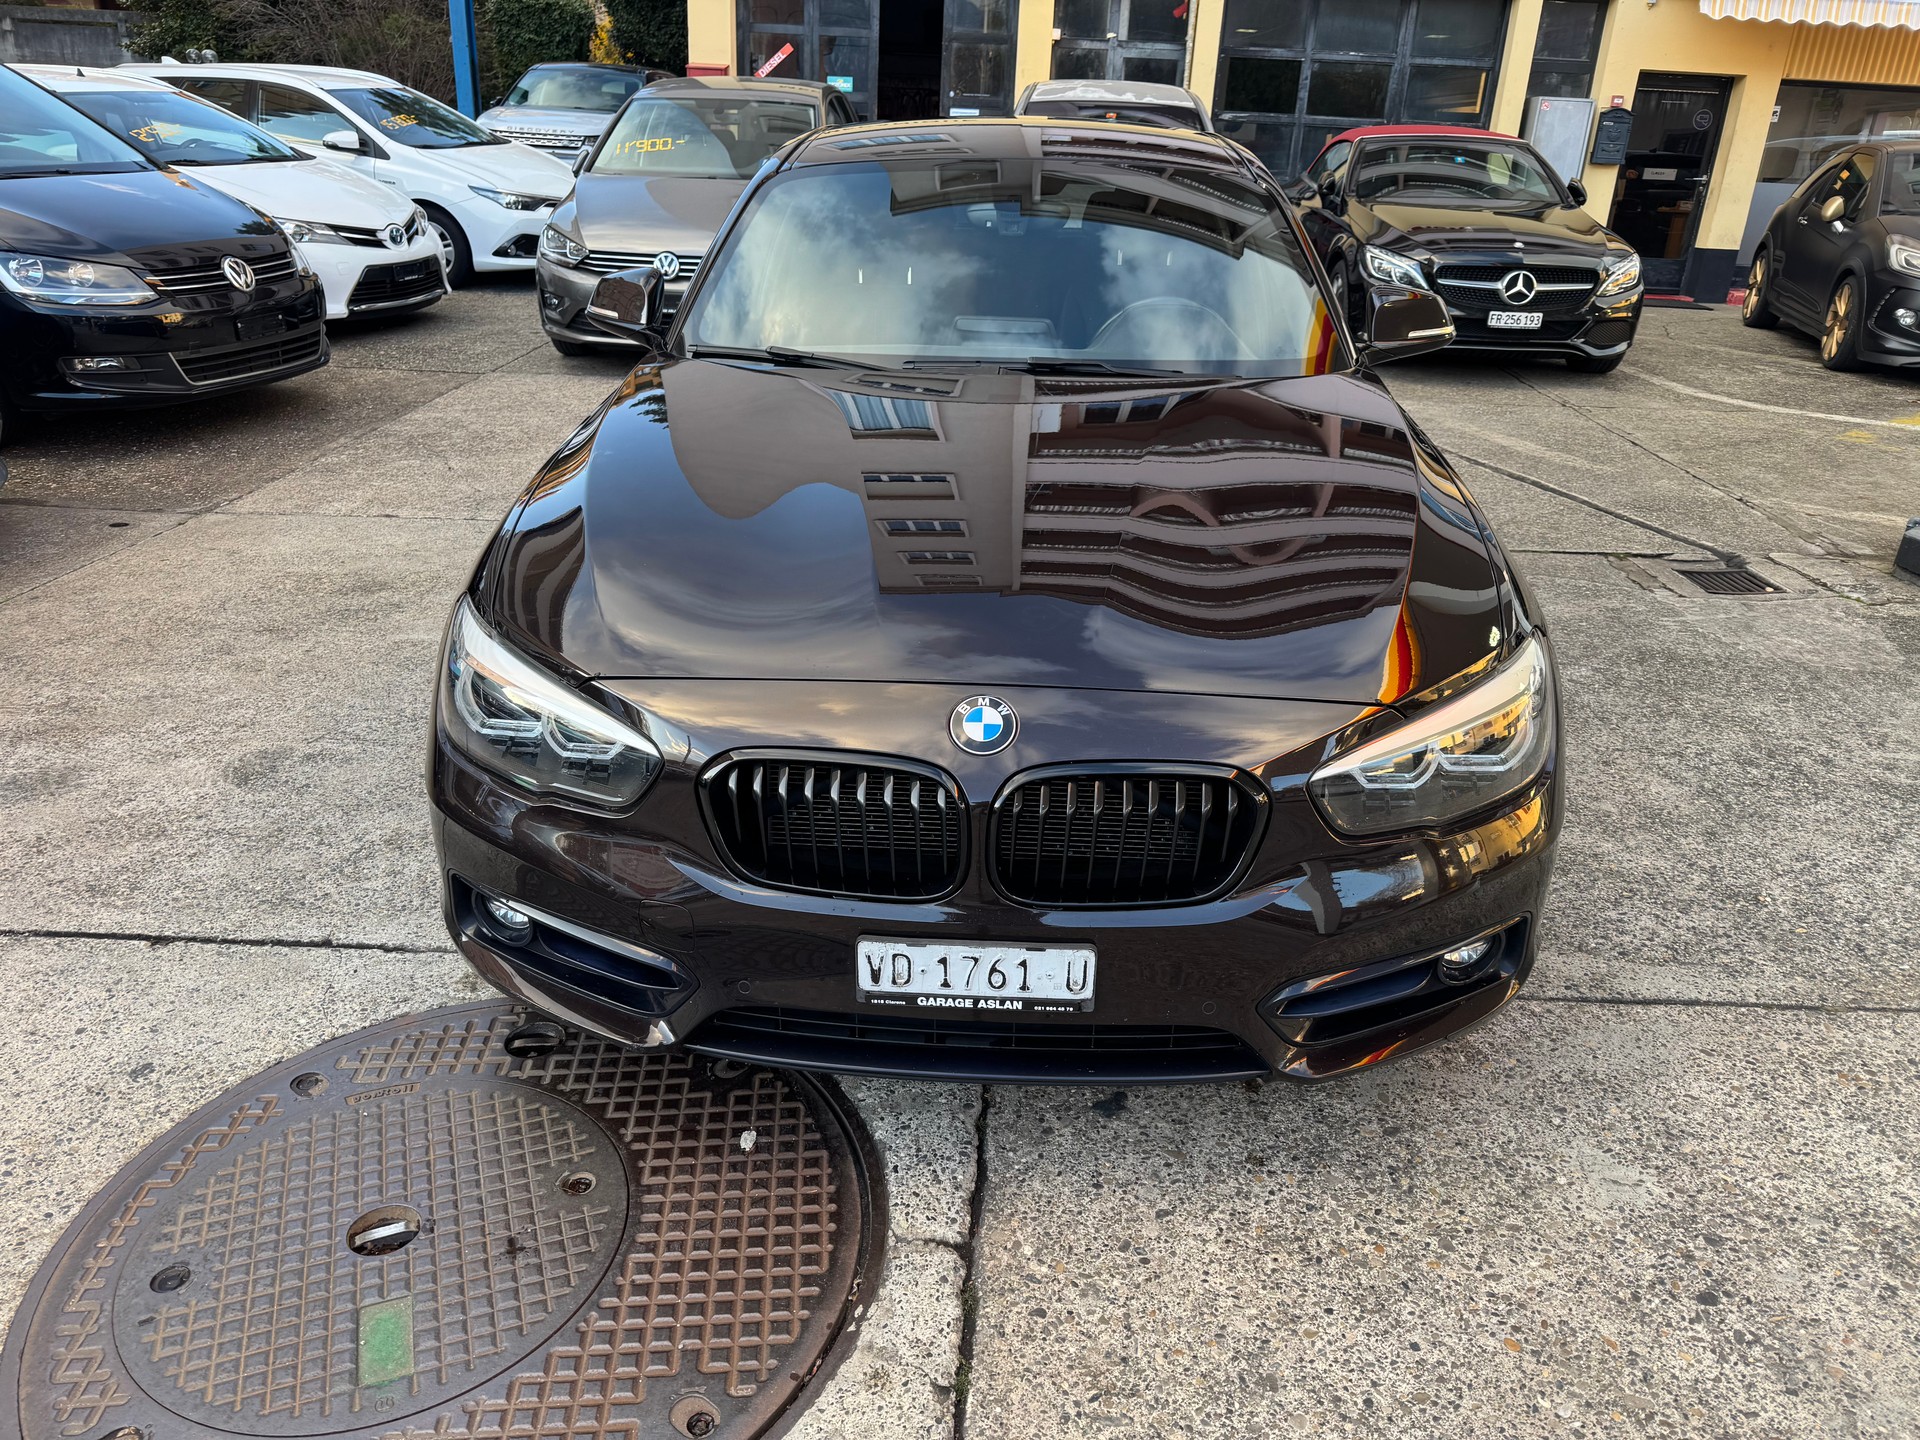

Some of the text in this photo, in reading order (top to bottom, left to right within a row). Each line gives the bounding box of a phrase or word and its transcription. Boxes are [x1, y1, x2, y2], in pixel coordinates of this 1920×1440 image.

[758, 52, 786, 78] DIESEL
[507, 126, 574, 134] DISCOVERY
[1524, 315, 1541, 325] 193
[958, 697, 1011, 716] BMW
[917, 997, 1023, 1010] GARAGE ASLAN
